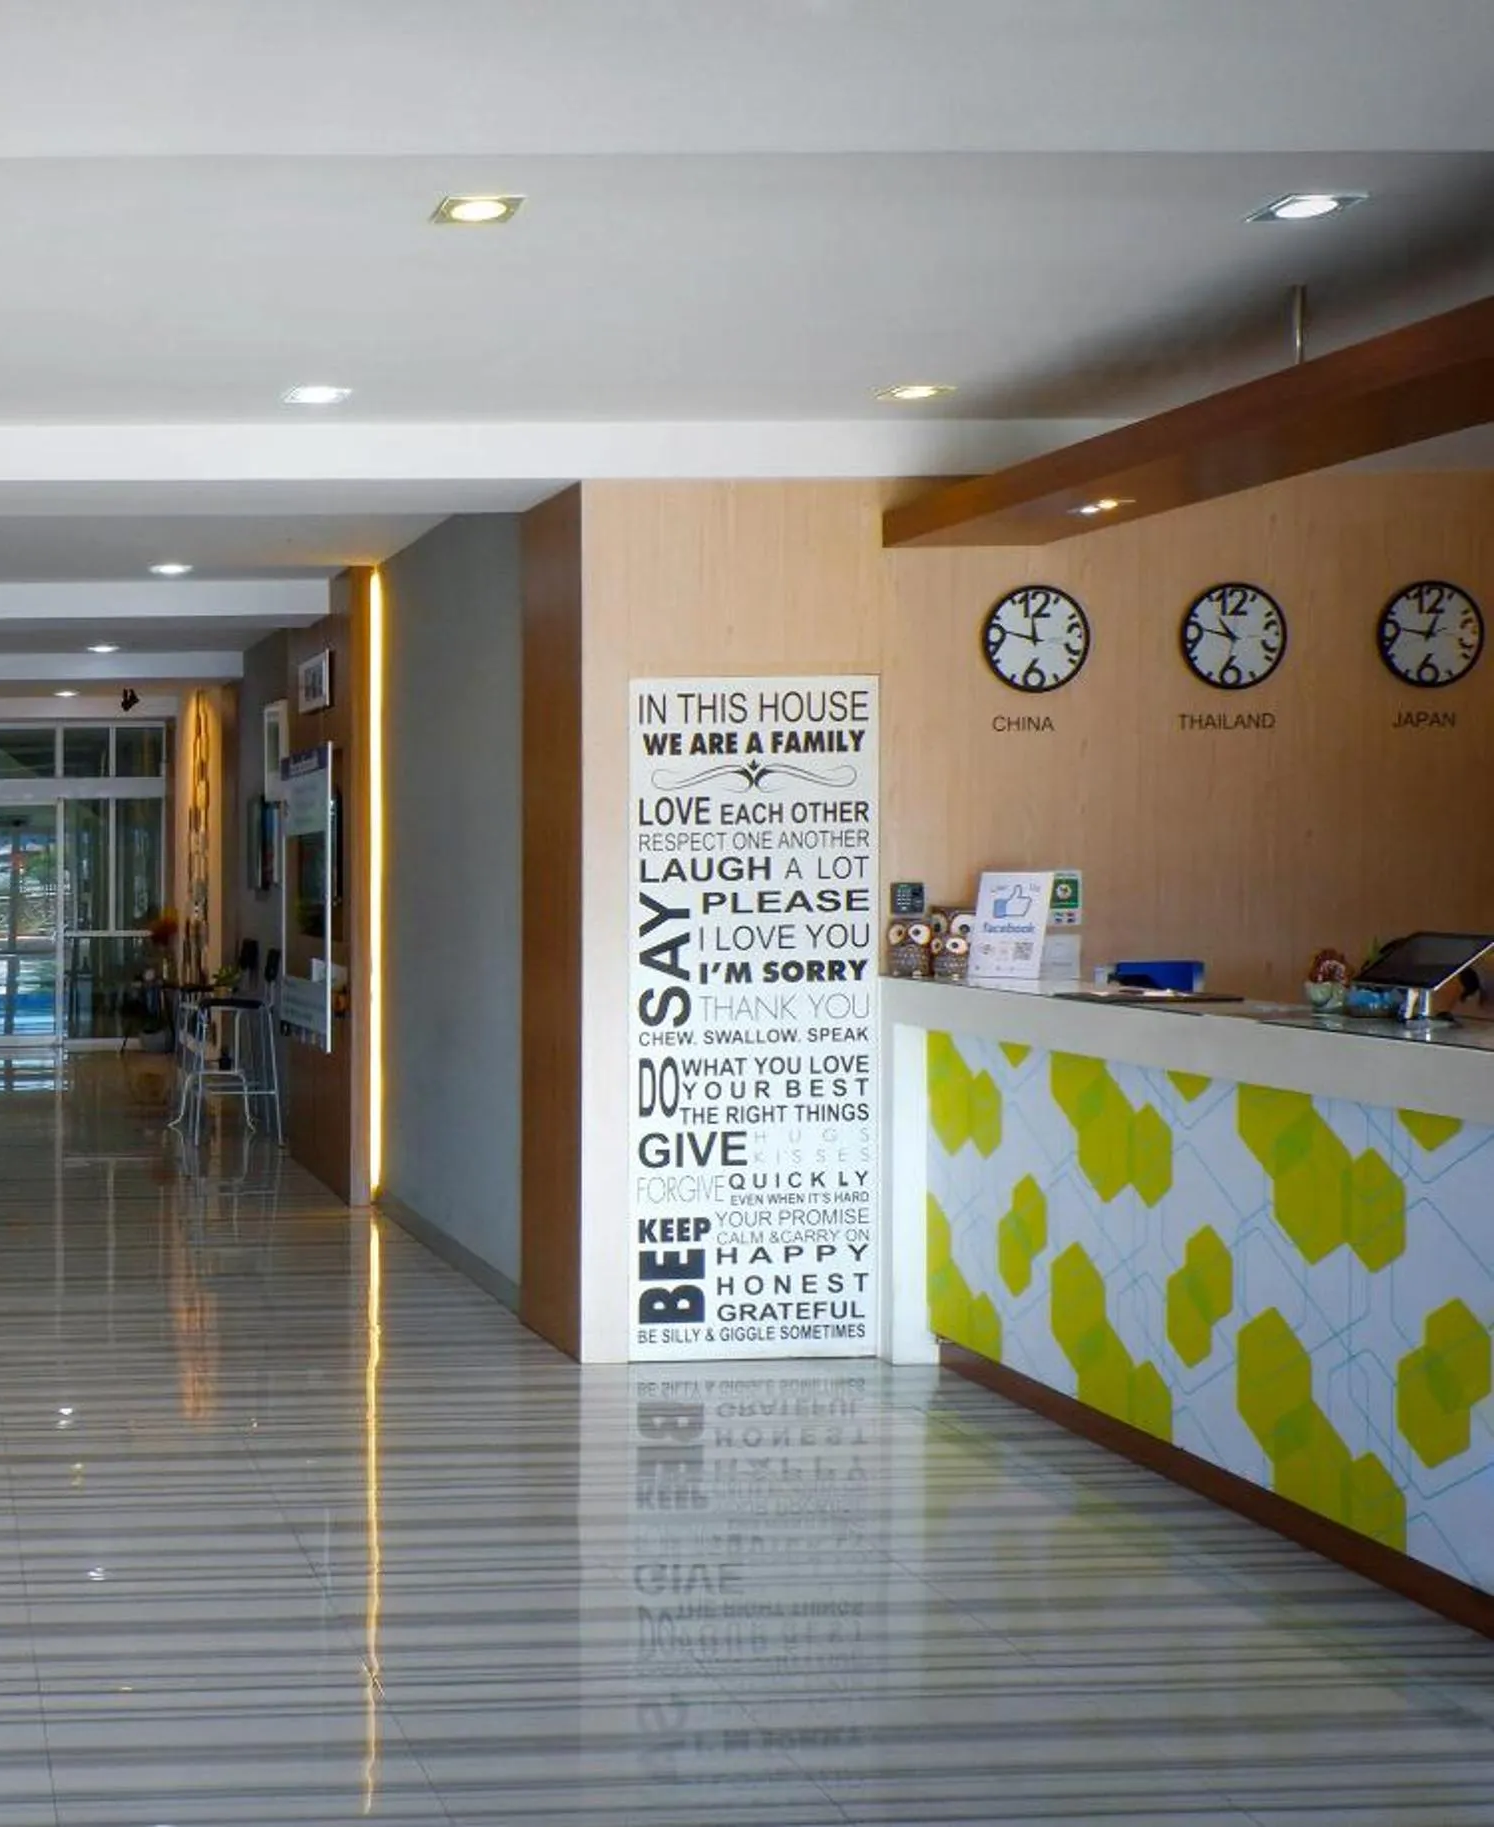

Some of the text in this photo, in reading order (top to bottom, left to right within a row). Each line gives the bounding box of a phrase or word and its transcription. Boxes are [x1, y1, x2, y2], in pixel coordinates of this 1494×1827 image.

[1018, 591, 1051, 618] 12
[1216, 588, 1248, 616] 12
[1413, 586, 1444, 614] 12
[987, 623, 1007, 656] 9
[1186, 620, 1204, 653] 9
[1023, 657, 1046, 689] 6
[1219, 655, 1242, 686] 6
[1417, 653, 1439, 683] 6
[639, 690, 870, 725] IN THIS HOUSE
[1392, 711, 1456, 728] JAPAN
[992, 715, 1055, 732] CHINA
[1179, 713, 1276, 731] THAILAND
[642, 729, 866, 756] WE ARE A FAMILY
[639, 796, 870, 826] LOVE EACH OTHER
[639, 829, 870, 851] RESPECT ONE ANOTHER
[640, 856, 870, 883] LAUGH A LOT
[702, 889, 870, 915] PLEASE
[699, 923, 870, 951] I LOVE YOU
[983, 922, 1035, 934] facebook
[638, 891, 692, 1028] SAY
[699, 959, 870, 984] I'M SORRY
[699, 993, 870, 1022] THANK YOU
[639, 1027, 869, 1047] CHEW. SWALLOW. SPEAK
[681, 1055, 870, 1077] WHAT YOU LOVE
[638, 1055, 680, 1119] DO
[682, 1078, 869, 1100] YOUR BEST
[679, 1103, 870, 1125] THE RIGHT THINGS
[638, 1131, 748, 1168] GIVE
[636, 1175, 725, 1204] FORGIVE
[728, 1170, 869, 1190] QUICKLY
[730, 1191, 869, 1206] EVEN WHEN IT'S HARD
[638, 1217, 712, 1243] KEEP
[716, 1208, 870, 1228] YOUR PROMISE
[716, 1231, 764, 1245] CALM
[845, 1228, 870, 1242] ON
[716, 1244, 869, 1265] HAPPY
[638, 1248, 706, 1324] BE
[716, 1272, 869, 1296] HONEST
[717, 1300, 866, 1322] GRATEFUL
[638, 1323, 866, 1344] BE SILLY & GIGGLE SOMETIMES
